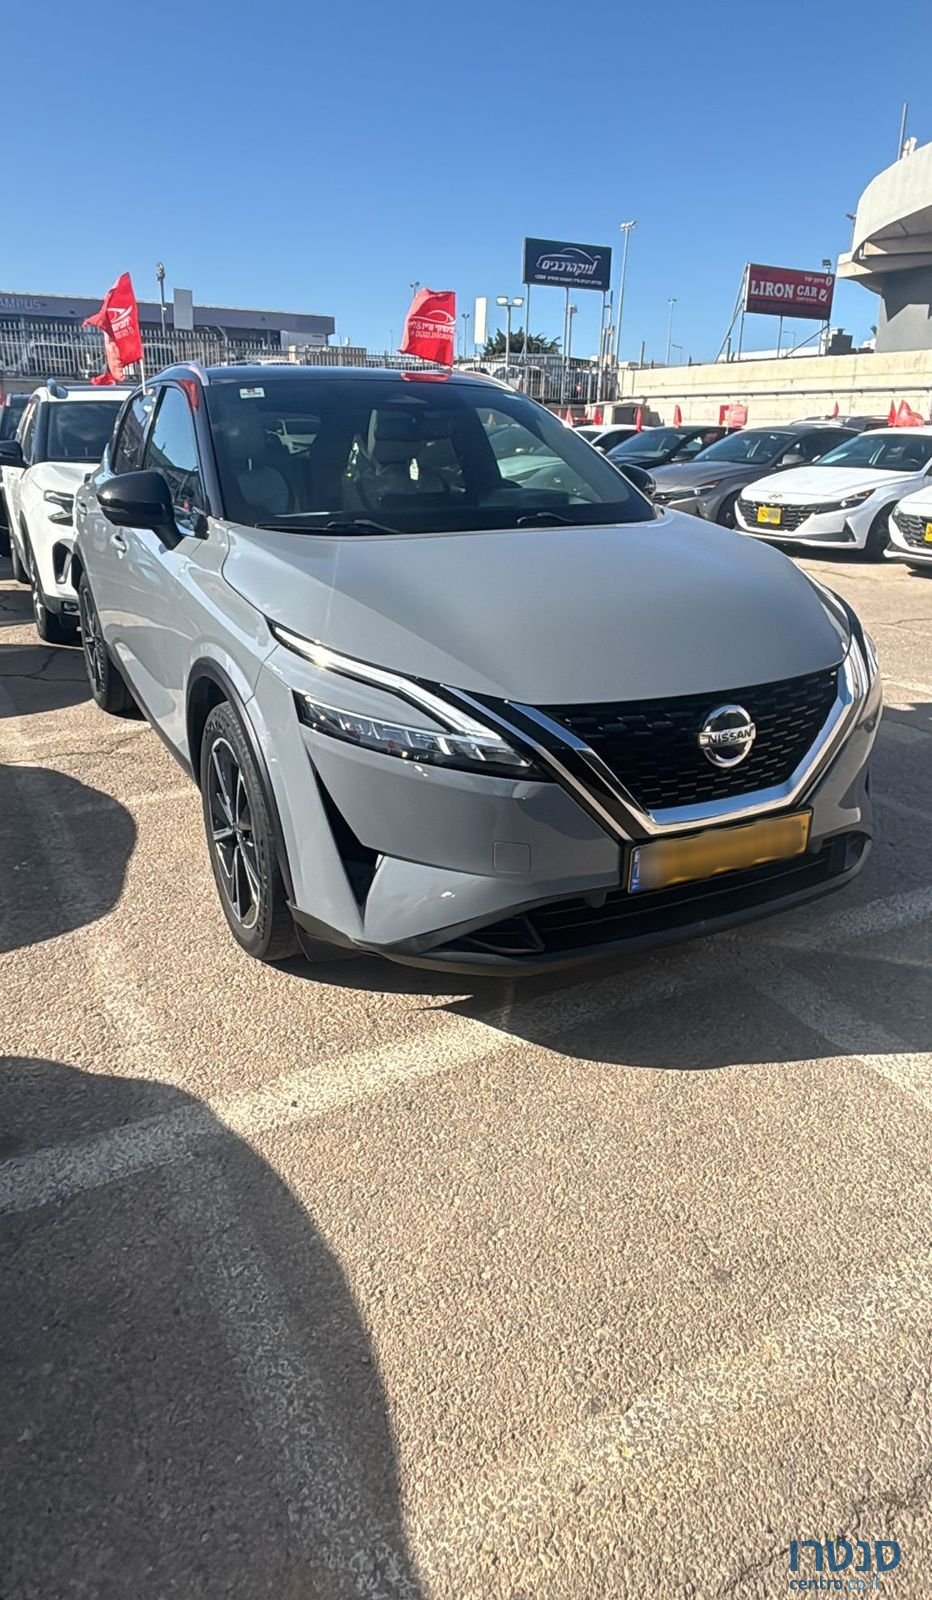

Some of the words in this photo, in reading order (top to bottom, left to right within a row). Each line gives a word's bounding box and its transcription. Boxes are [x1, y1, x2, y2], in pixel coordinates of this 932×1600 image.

[751, 281, 795, 298] LIRON
[797, 285, 817, 297] CAR
[708, 729, 752, 743] NISSAN
